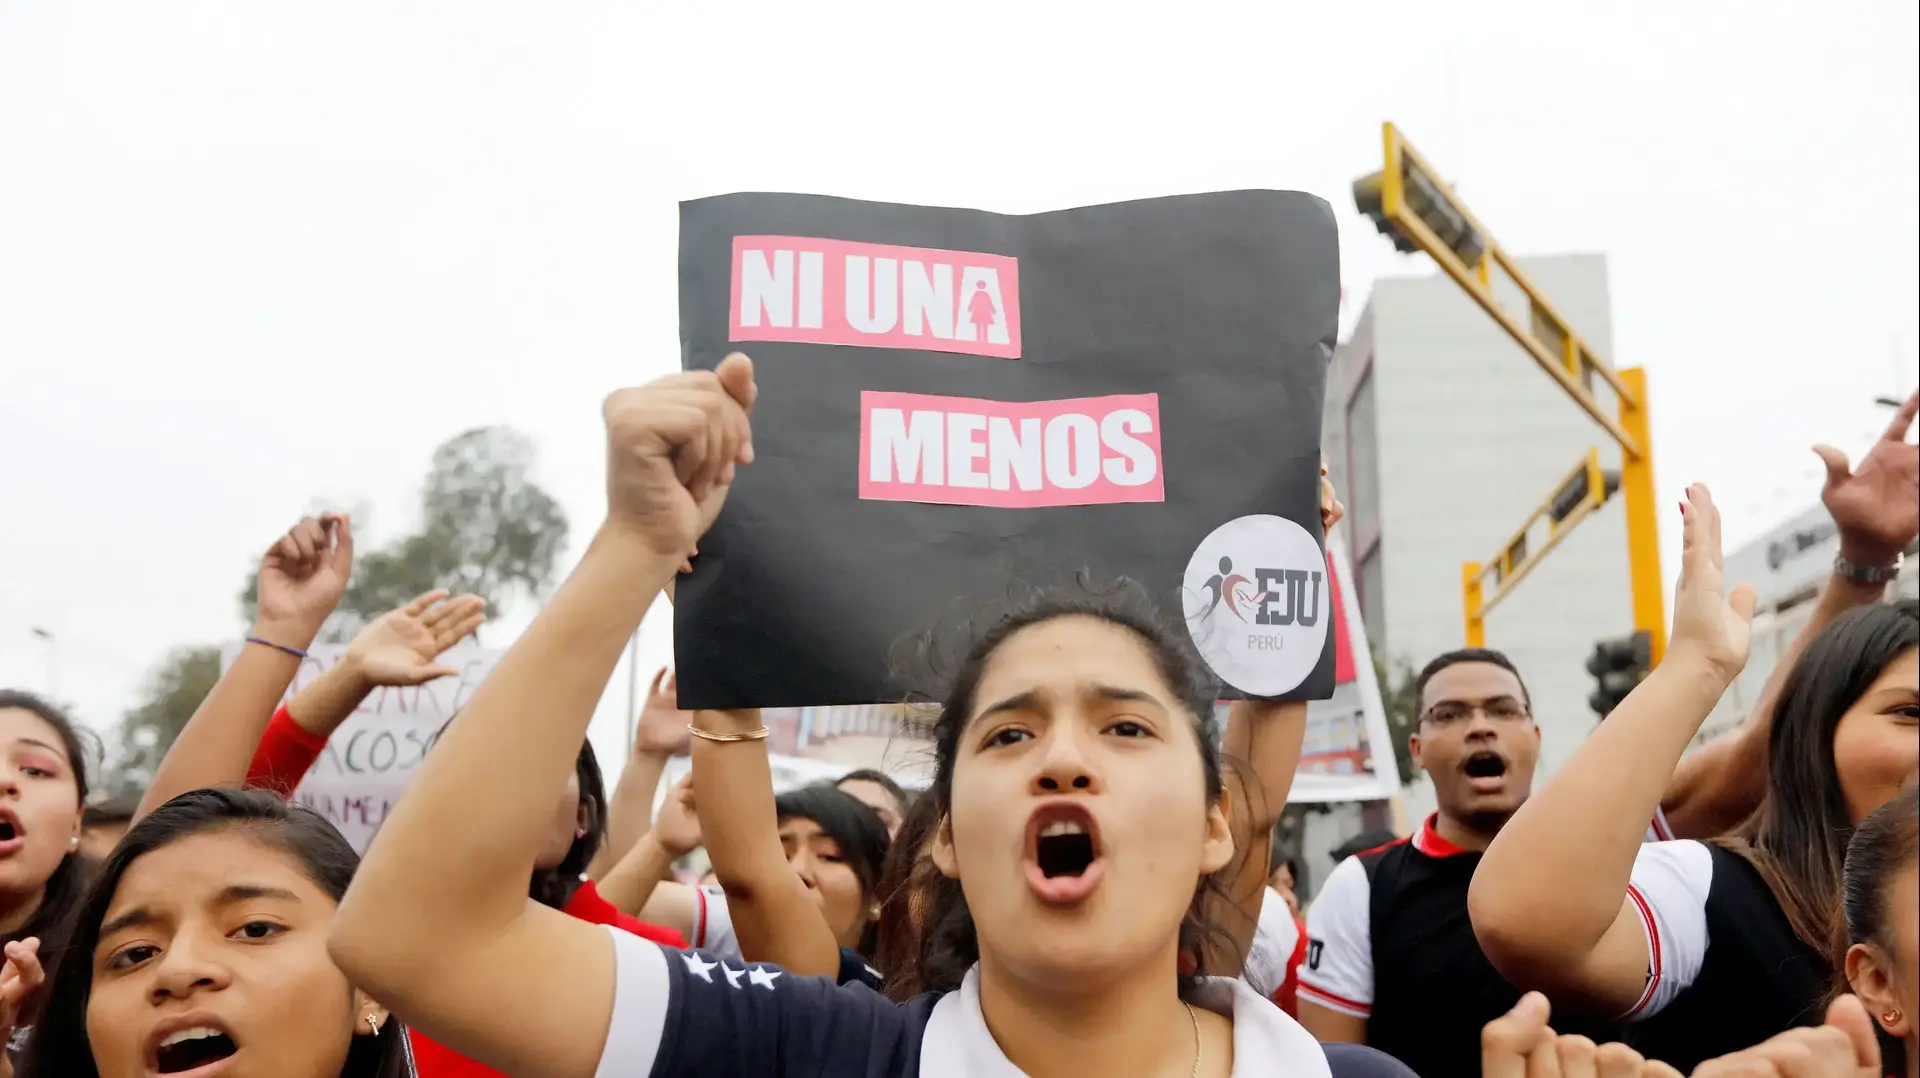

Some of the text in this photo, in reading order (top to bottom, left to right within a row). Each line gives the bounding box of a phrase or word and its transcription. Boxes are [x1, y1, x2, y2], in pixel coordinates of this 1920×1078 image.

[740, 249, 1011, 345] NI UNA
[869, 407, 1158, 491] MENOS
[1255, 567, 1322, 627] EJU
[1247, 632, 1284, 650] PERÚ
